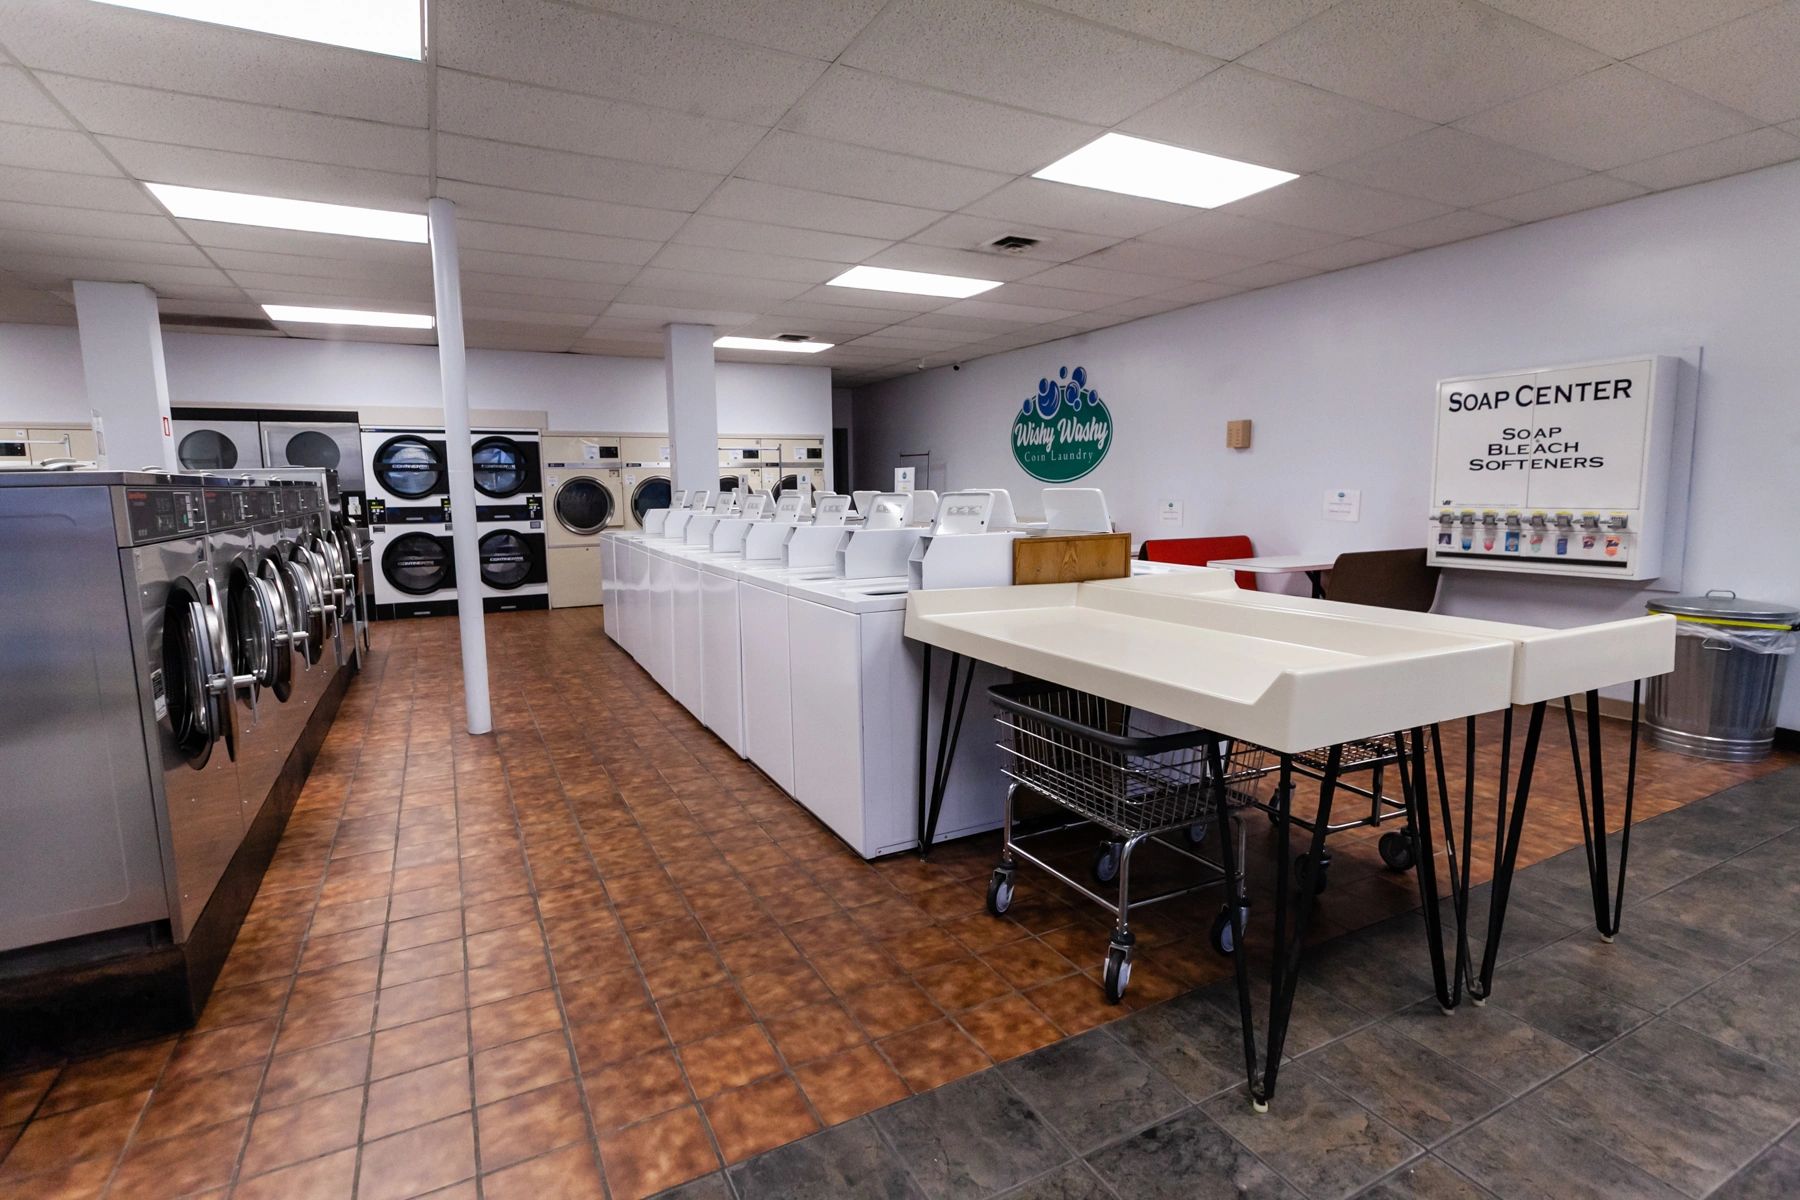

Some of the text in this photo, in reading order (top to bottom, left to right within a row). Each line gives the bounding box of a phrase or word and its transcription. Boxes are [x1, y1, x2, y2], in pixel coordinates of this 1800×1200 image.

[1449, 379, 1632, 412] SOAP CENTER
[1014, 416, 1108, 453] Wishy Washy
[1502, 427, 1562, 440] SOAP
[1024, 448, 1094, 463] Coin Laundry
[1488, 441, 1579, 456] BLEACH
[1469, 456, 1605, 471] SOFTENERS
